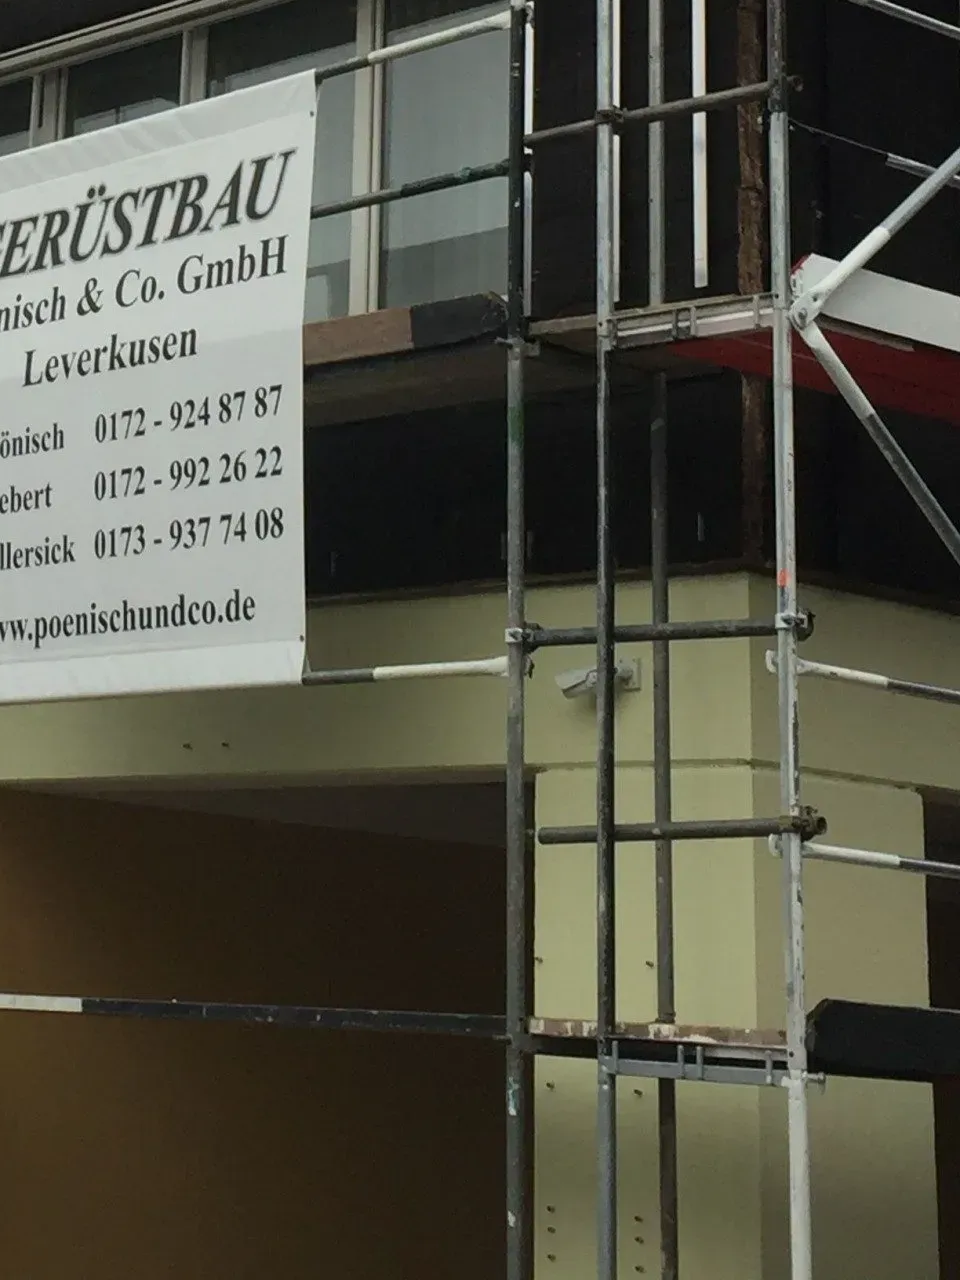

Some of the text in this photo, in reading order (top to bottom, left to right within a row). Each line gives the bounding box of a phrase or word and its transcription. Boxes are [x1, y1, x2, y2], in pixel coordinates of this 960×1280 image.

[76, 277, 104, 316] &
[115, 269, 166, 308] Co.
[177, 235, 288, 296] GmbH
[22, 328, 199, 388] Leverkusen
[95, 408, 147, 444] 0172
[169, 398, 211, 432] 924
[218, 391, 246, 423] 87
[254, 384, 283, 418] 87
[94, 465, 146, 502] 0172
[169, 456, 211, 491] 992
[219, 451, 248, 484] 26
[254, 446, 283, 478] 22
[94, 524, 146, 560] 0173
[169, 516, 211, 550] 937
[218, 512, 249, 543] 74
[254, 507, 284, 538] 08
